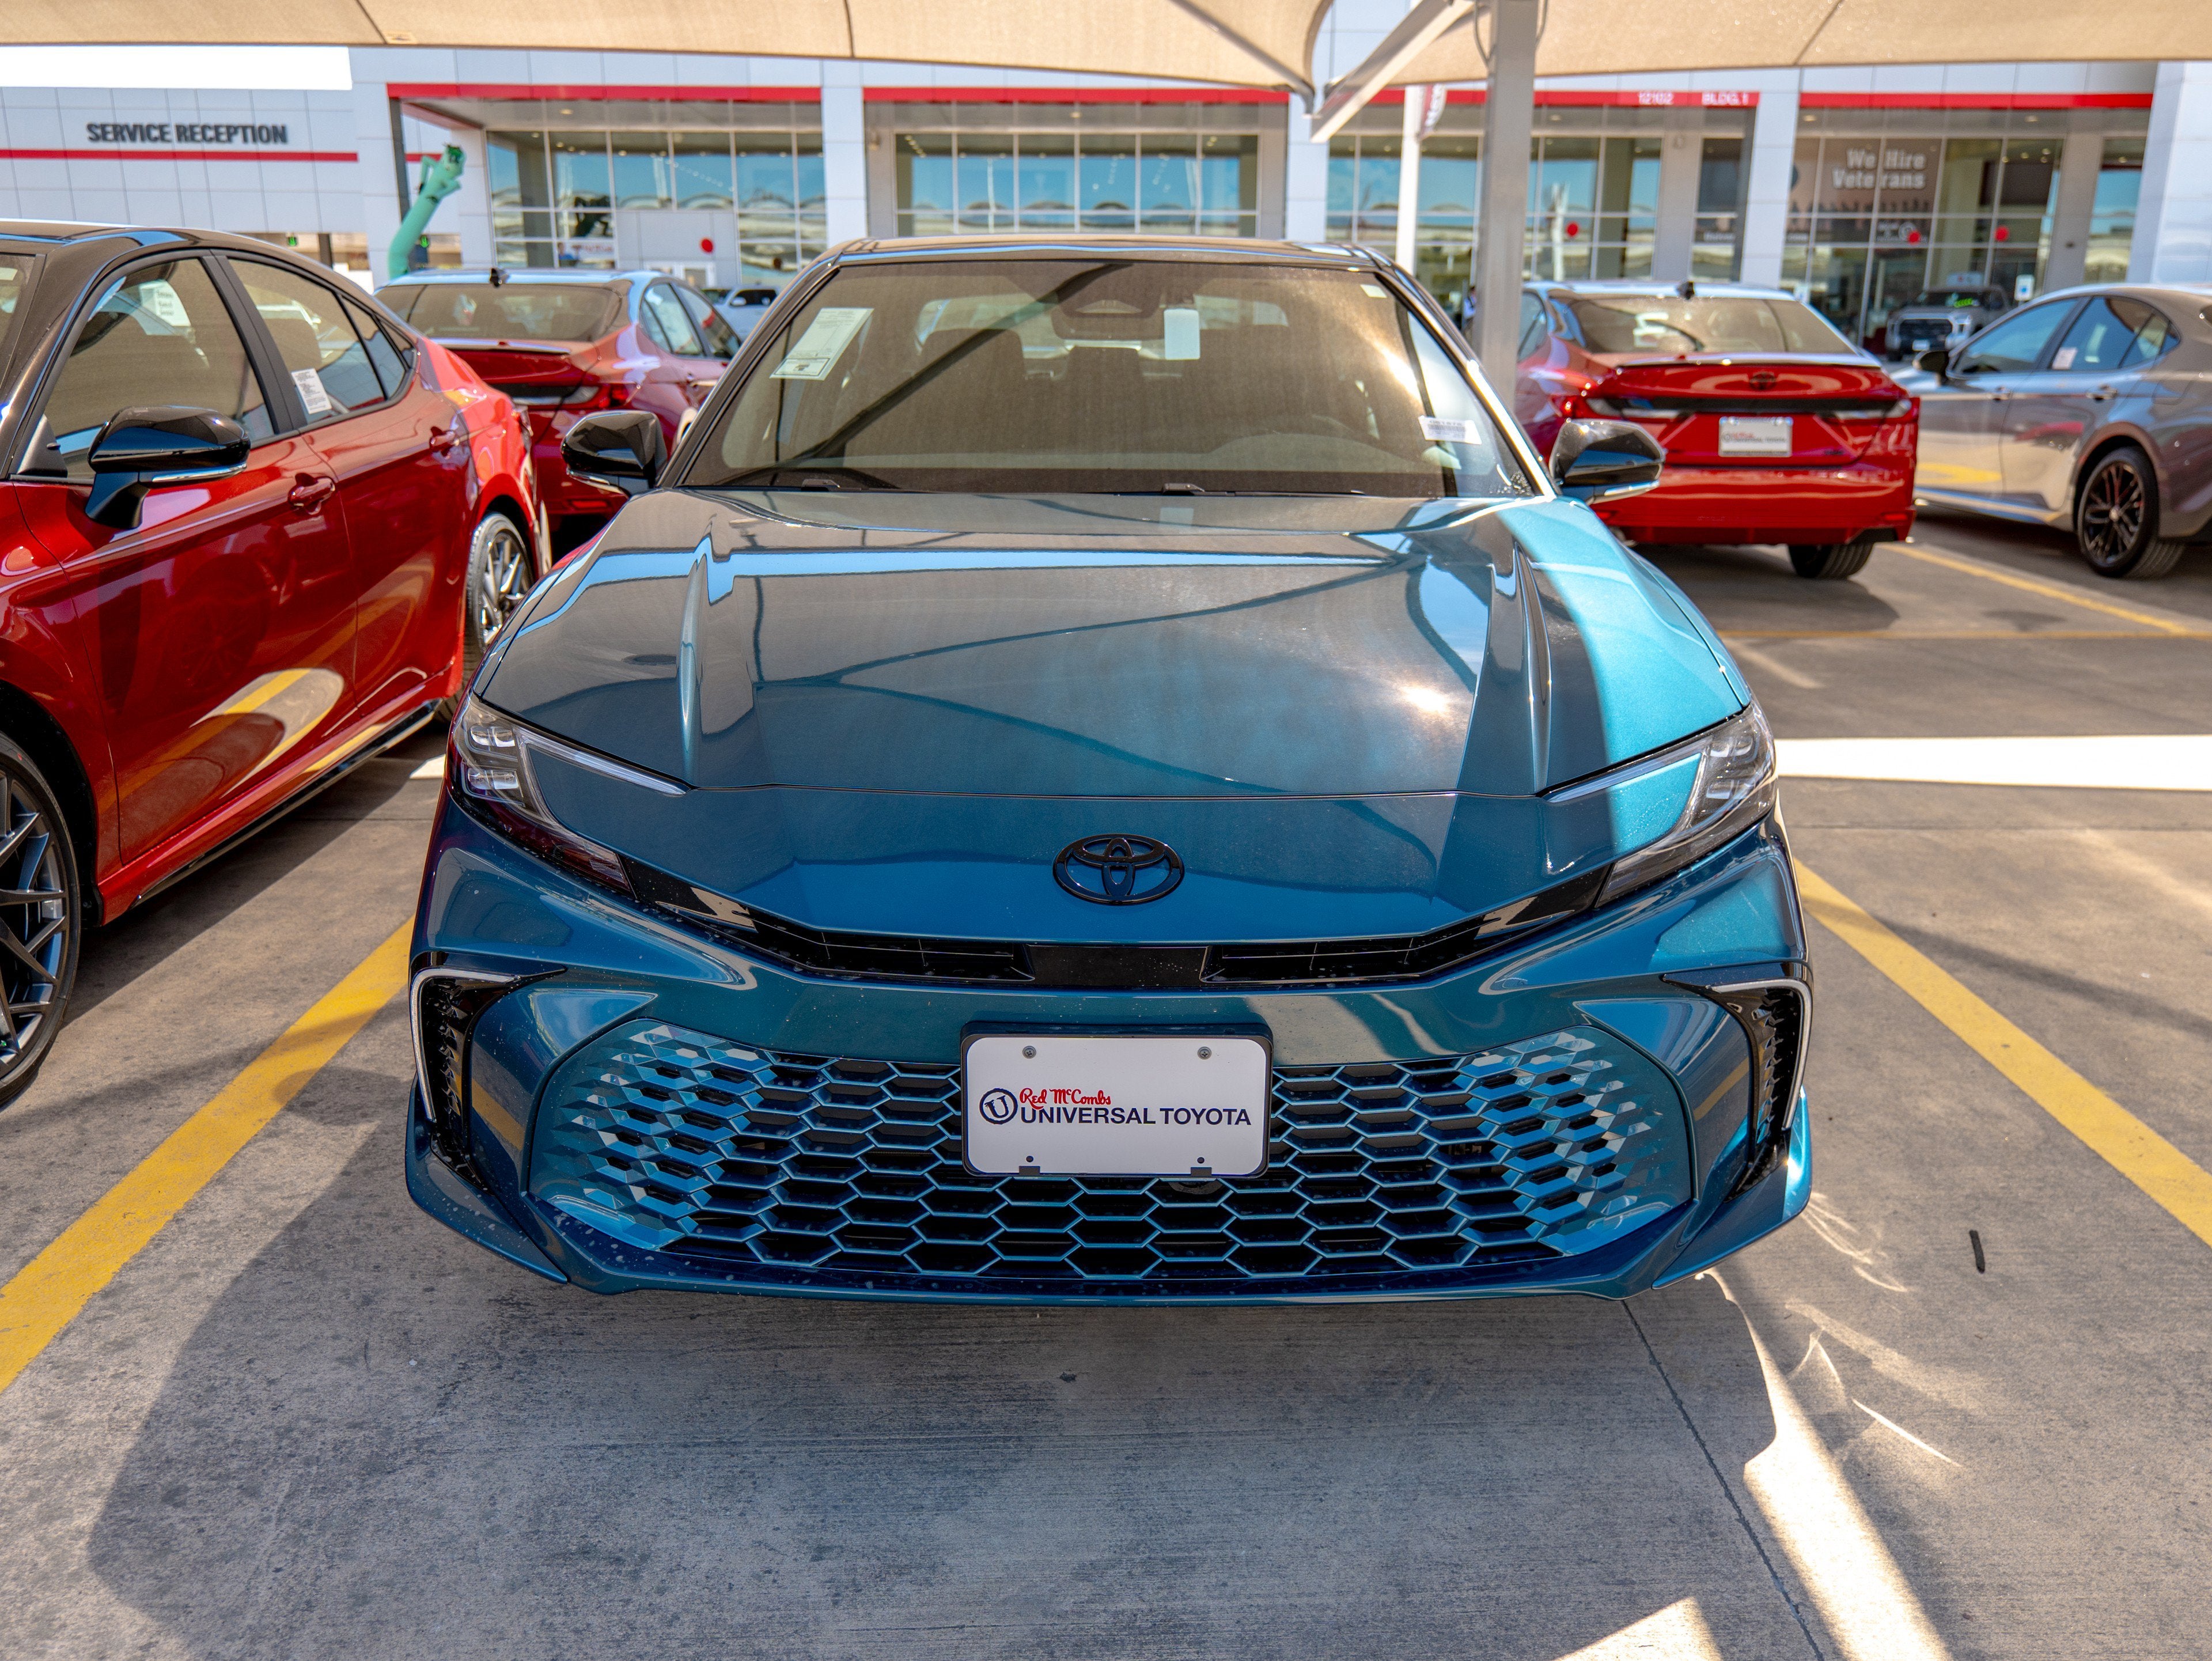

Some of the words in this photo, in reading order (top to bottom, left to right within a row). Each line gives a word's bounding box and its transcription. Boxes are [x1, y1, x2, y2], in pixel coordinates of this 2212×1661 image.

[86, 123, 171, 143] SERVICE
[175, 123, 287, 144] RECEPTION
[1846, 148, 1877, 170] We
[1884, 148, 1926, 171] Hire
[1832, 167, 1926, 190] Veterans
[1020, 1088, 1047, 1110] Red
[1049, 1088, 1112, 1106] McCombs
[1021, 1106, 1156, 1125] UNIVERSAL
[1160, 1107, 1252, 1126] TOYOTA
